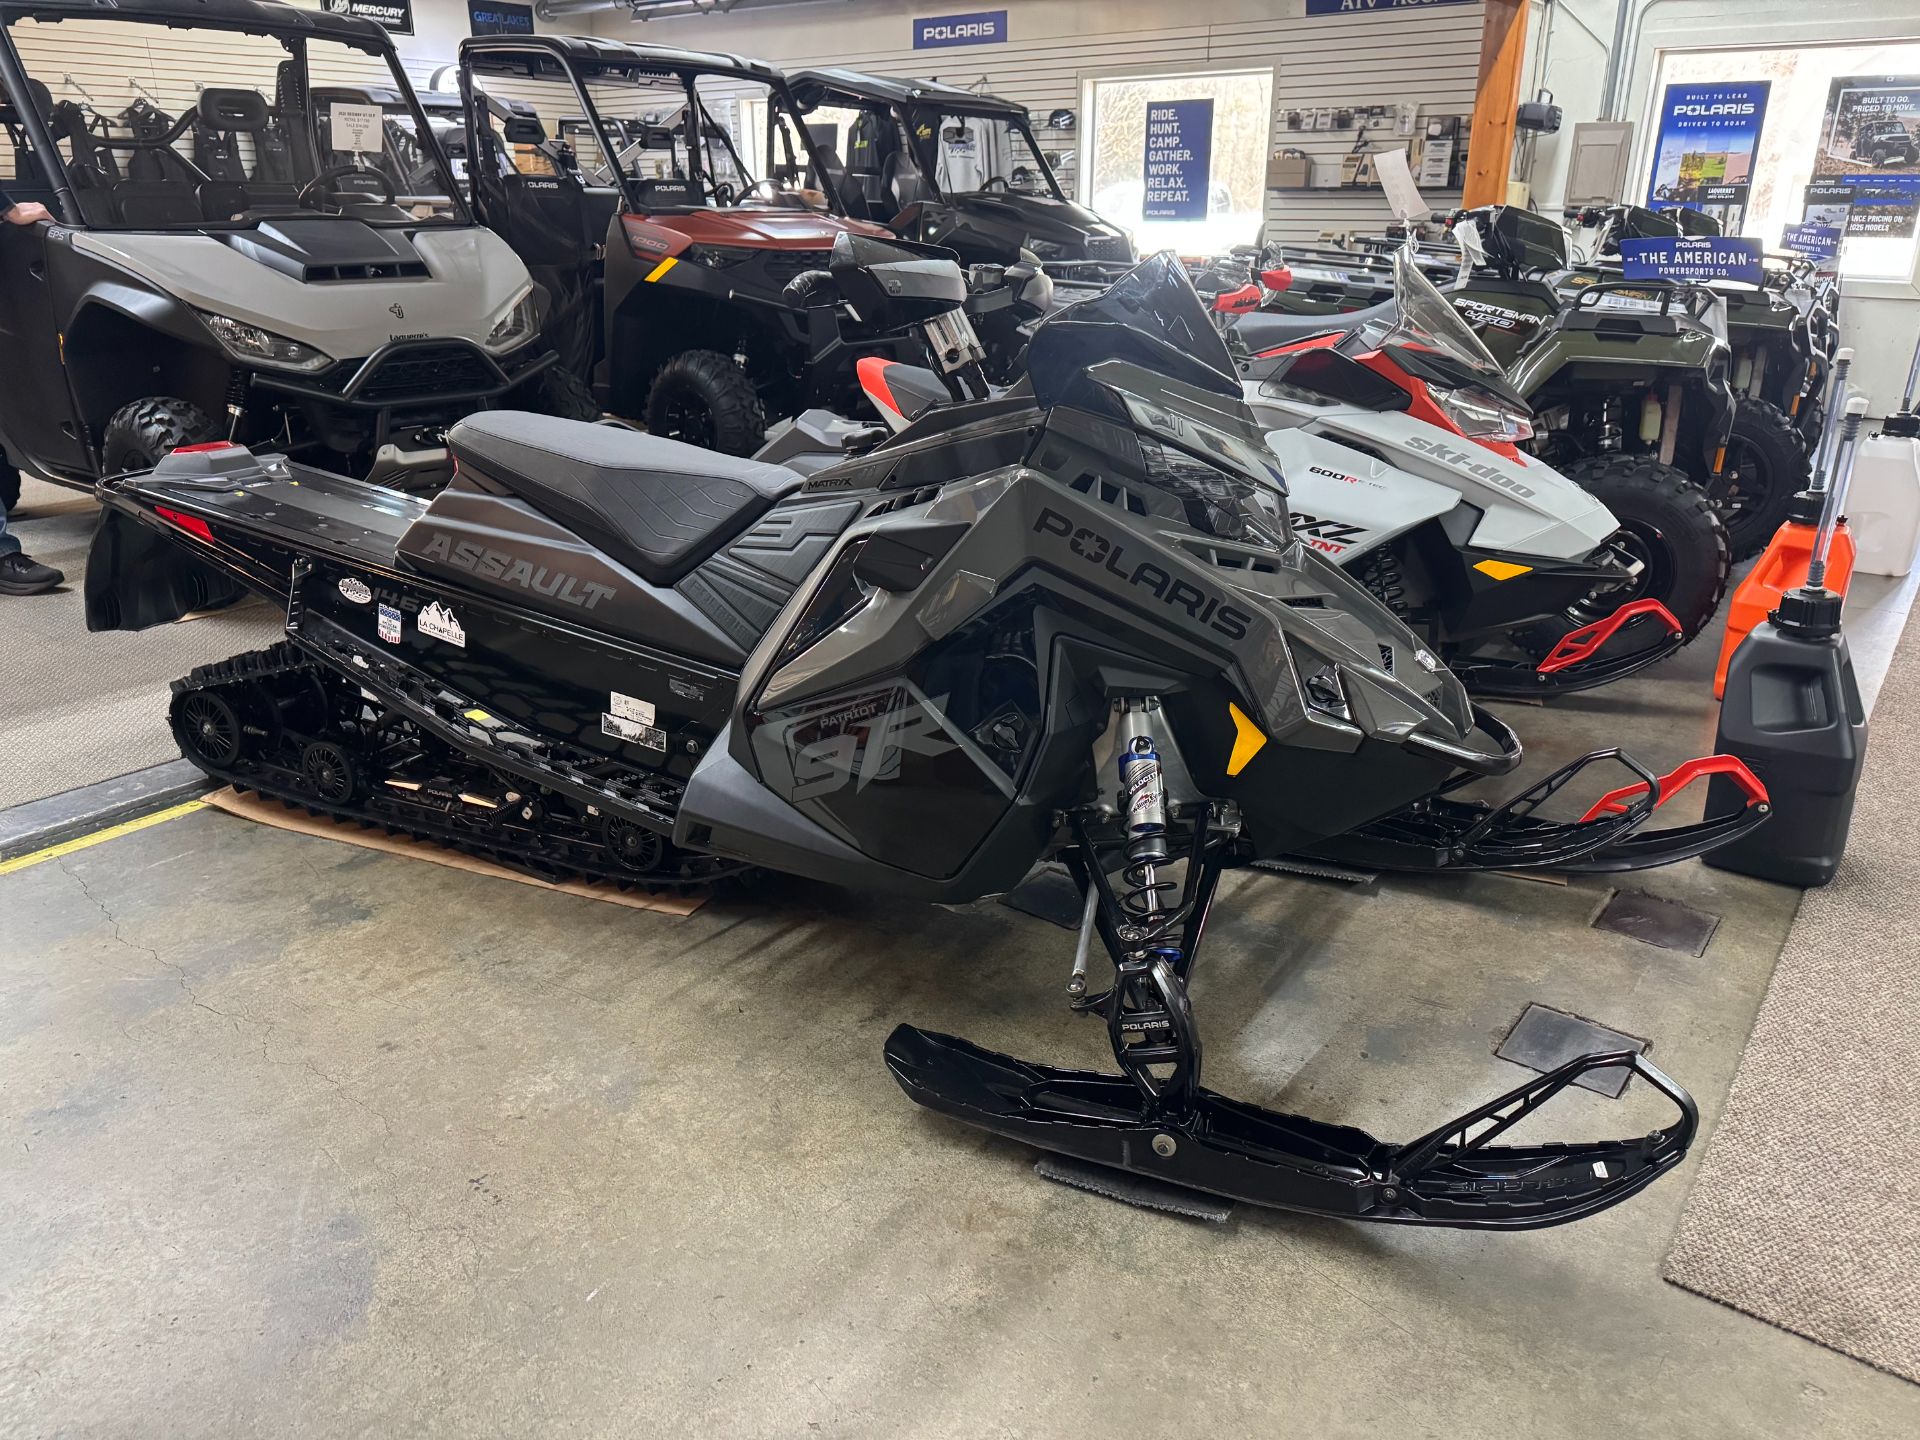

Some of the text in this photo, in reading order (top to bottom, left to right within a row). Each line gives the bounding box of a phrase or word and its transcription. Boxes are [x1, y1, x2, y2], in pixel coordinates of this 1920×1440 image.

[351, 3, 405, 18] MERCURY
[502, 12, 530, 26] LAKES
[923, 22, 995, 41] POLARIS
[1861, 96, 1883, 104] BUILT
[1886, 95, 1896, 103] TO
[1150, 108, 1179, 121] RIDE.
[1673, 103, 1755, 116] POLARIS
[1851, 104, 1880, 112] PRICED
[1882, 104, 1892, 112] TO
[1149, 122, 1181, 135] HUNT.
[1149, 136, 1183, 148] CAMP.
[1148, 149, 1194, 162] GATHER.
[1148, 163, 1183, 175] WORK.
[521, 180, 559, 189] OLARIS
[1147, 177, 1187, 189] RELAX.
[1146, 190, 1190, 202] REPEAT.
[1893, 215, 1904, 223] ON
[48, 229, 65, 241] EPS
[1786, 232, 1832, 246] THE AMERICAN
[631, 235, 669, 250] 1000
[1675, 241, 1712, 249] POLARIS
[1639, 252, 1747, 266] THE AMERICAN
[1658, 266, 1729, 276] POWERSPORTS CO.
[1453, 298, 1547, 326] SPORTSMAN
[807, 477, 853, 490] MATRYX
[1310, 538, 1347, 555] TNT
[421, 532, 617, 609] ASSAULT
[1032, 507, 1252, 641] POLARIS
[420, 619, 428, 628] LA
[429, 622, 464, 641] CHAPELLE
[820, 703, 877, 729] PATRIOT
[1121, 1020, 1170, 1031] POLARIS
